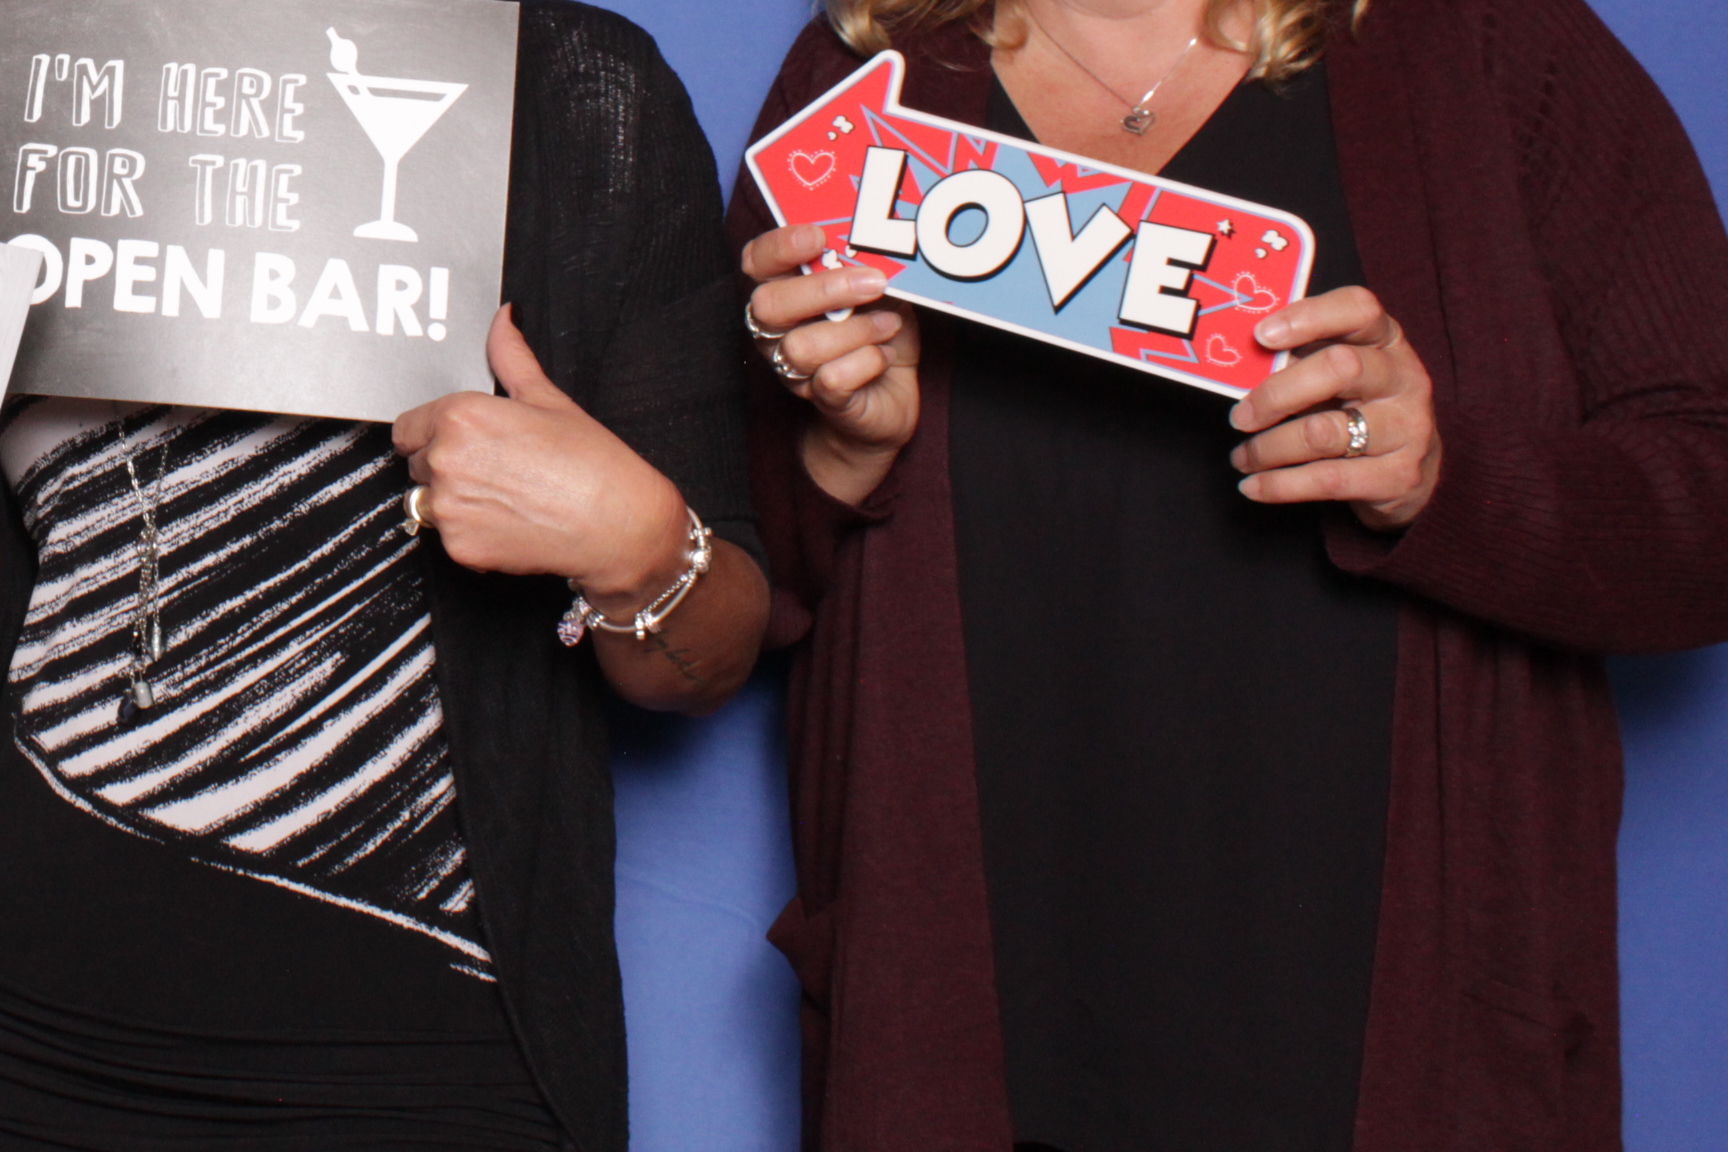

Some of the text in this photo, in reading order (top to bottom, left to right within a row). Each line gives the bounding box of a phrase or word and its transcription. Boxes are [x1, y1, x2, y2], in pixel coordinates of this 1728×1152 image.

[24, 53, 307, 144] I'M HERE
[13, 142, 303, 232] FOR THE
[847, 144, 1216, 340] LOVE
[250, 251, 449, 341] BAR!
